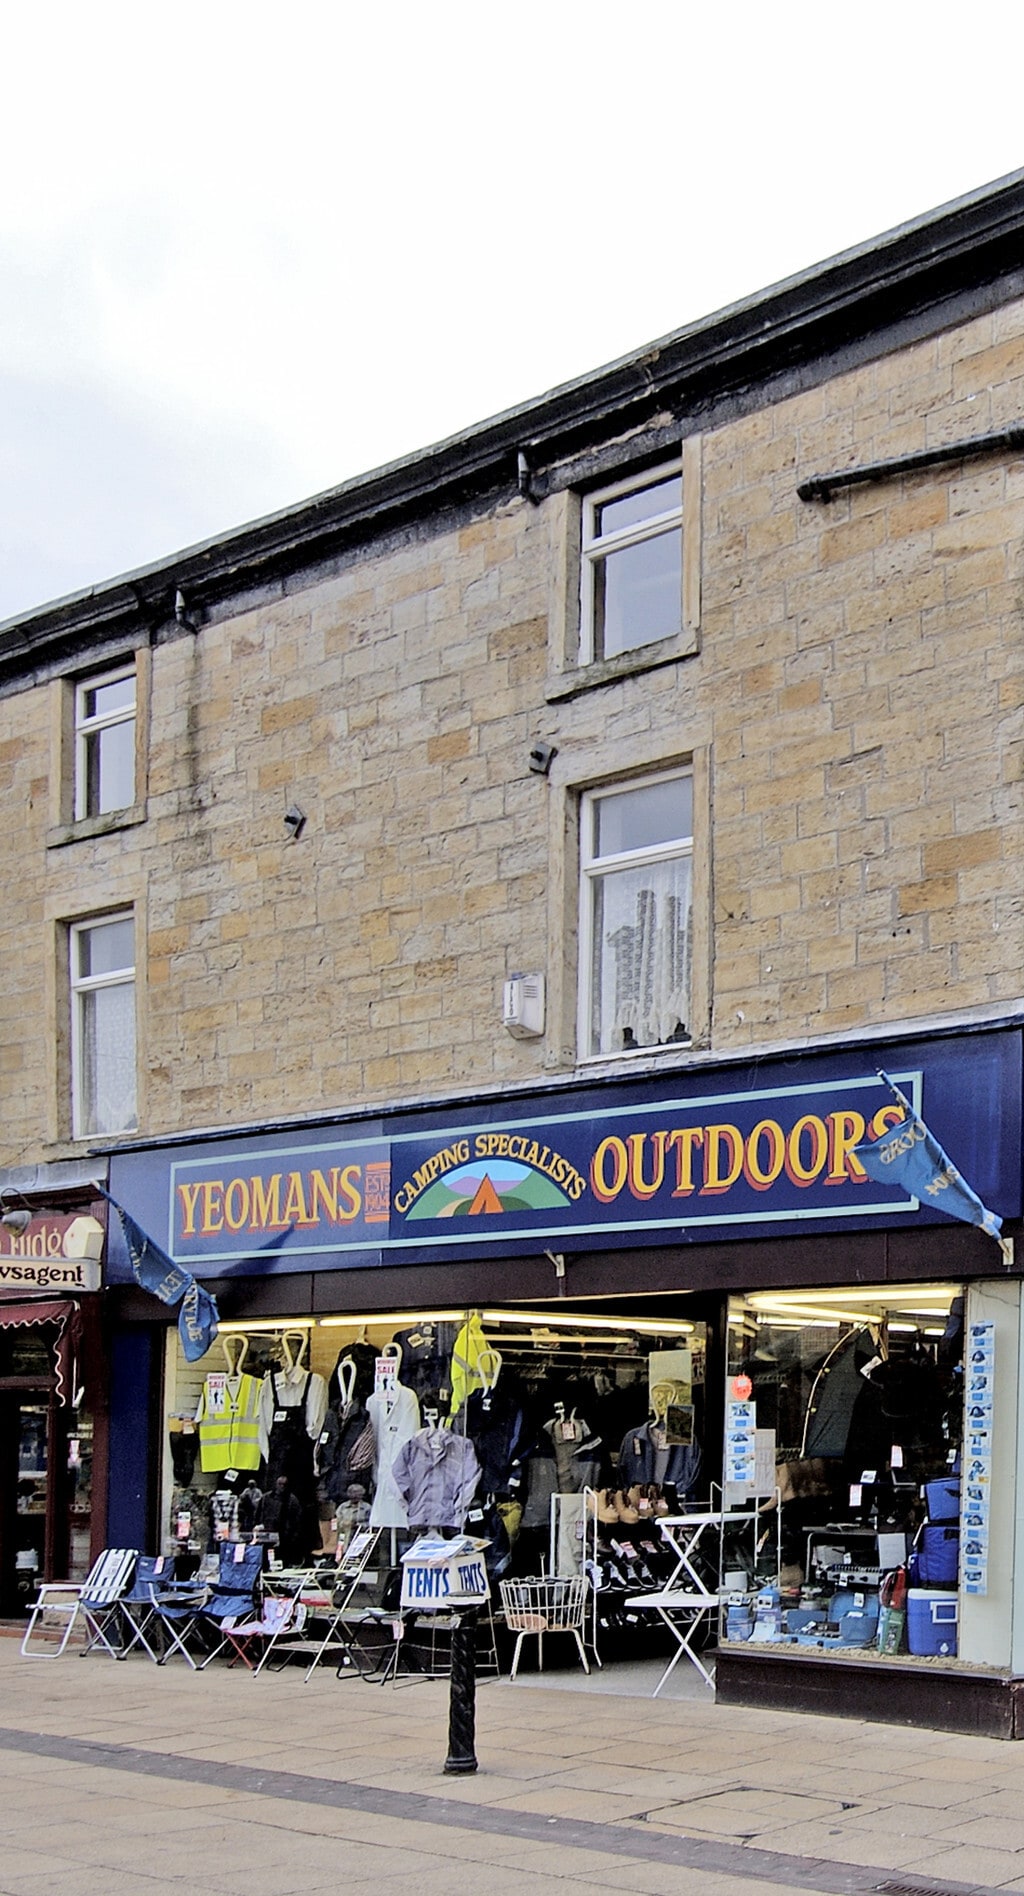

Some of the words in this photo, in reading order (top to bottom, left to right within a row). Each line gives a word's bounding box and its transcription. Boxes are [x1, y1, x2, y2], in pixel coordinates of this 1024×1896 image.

[394, 1139, 470, 1213] CAMPING
[475, 1134, 587, 1200] SPECIALISTS
[178, 1165, 362, 1238] YEOMANS
[10, 1225, 61, 1257] Fudg
[407, 1567, 449, 1597] TENTS
[458, 1562, 487, 1593] TENTS
